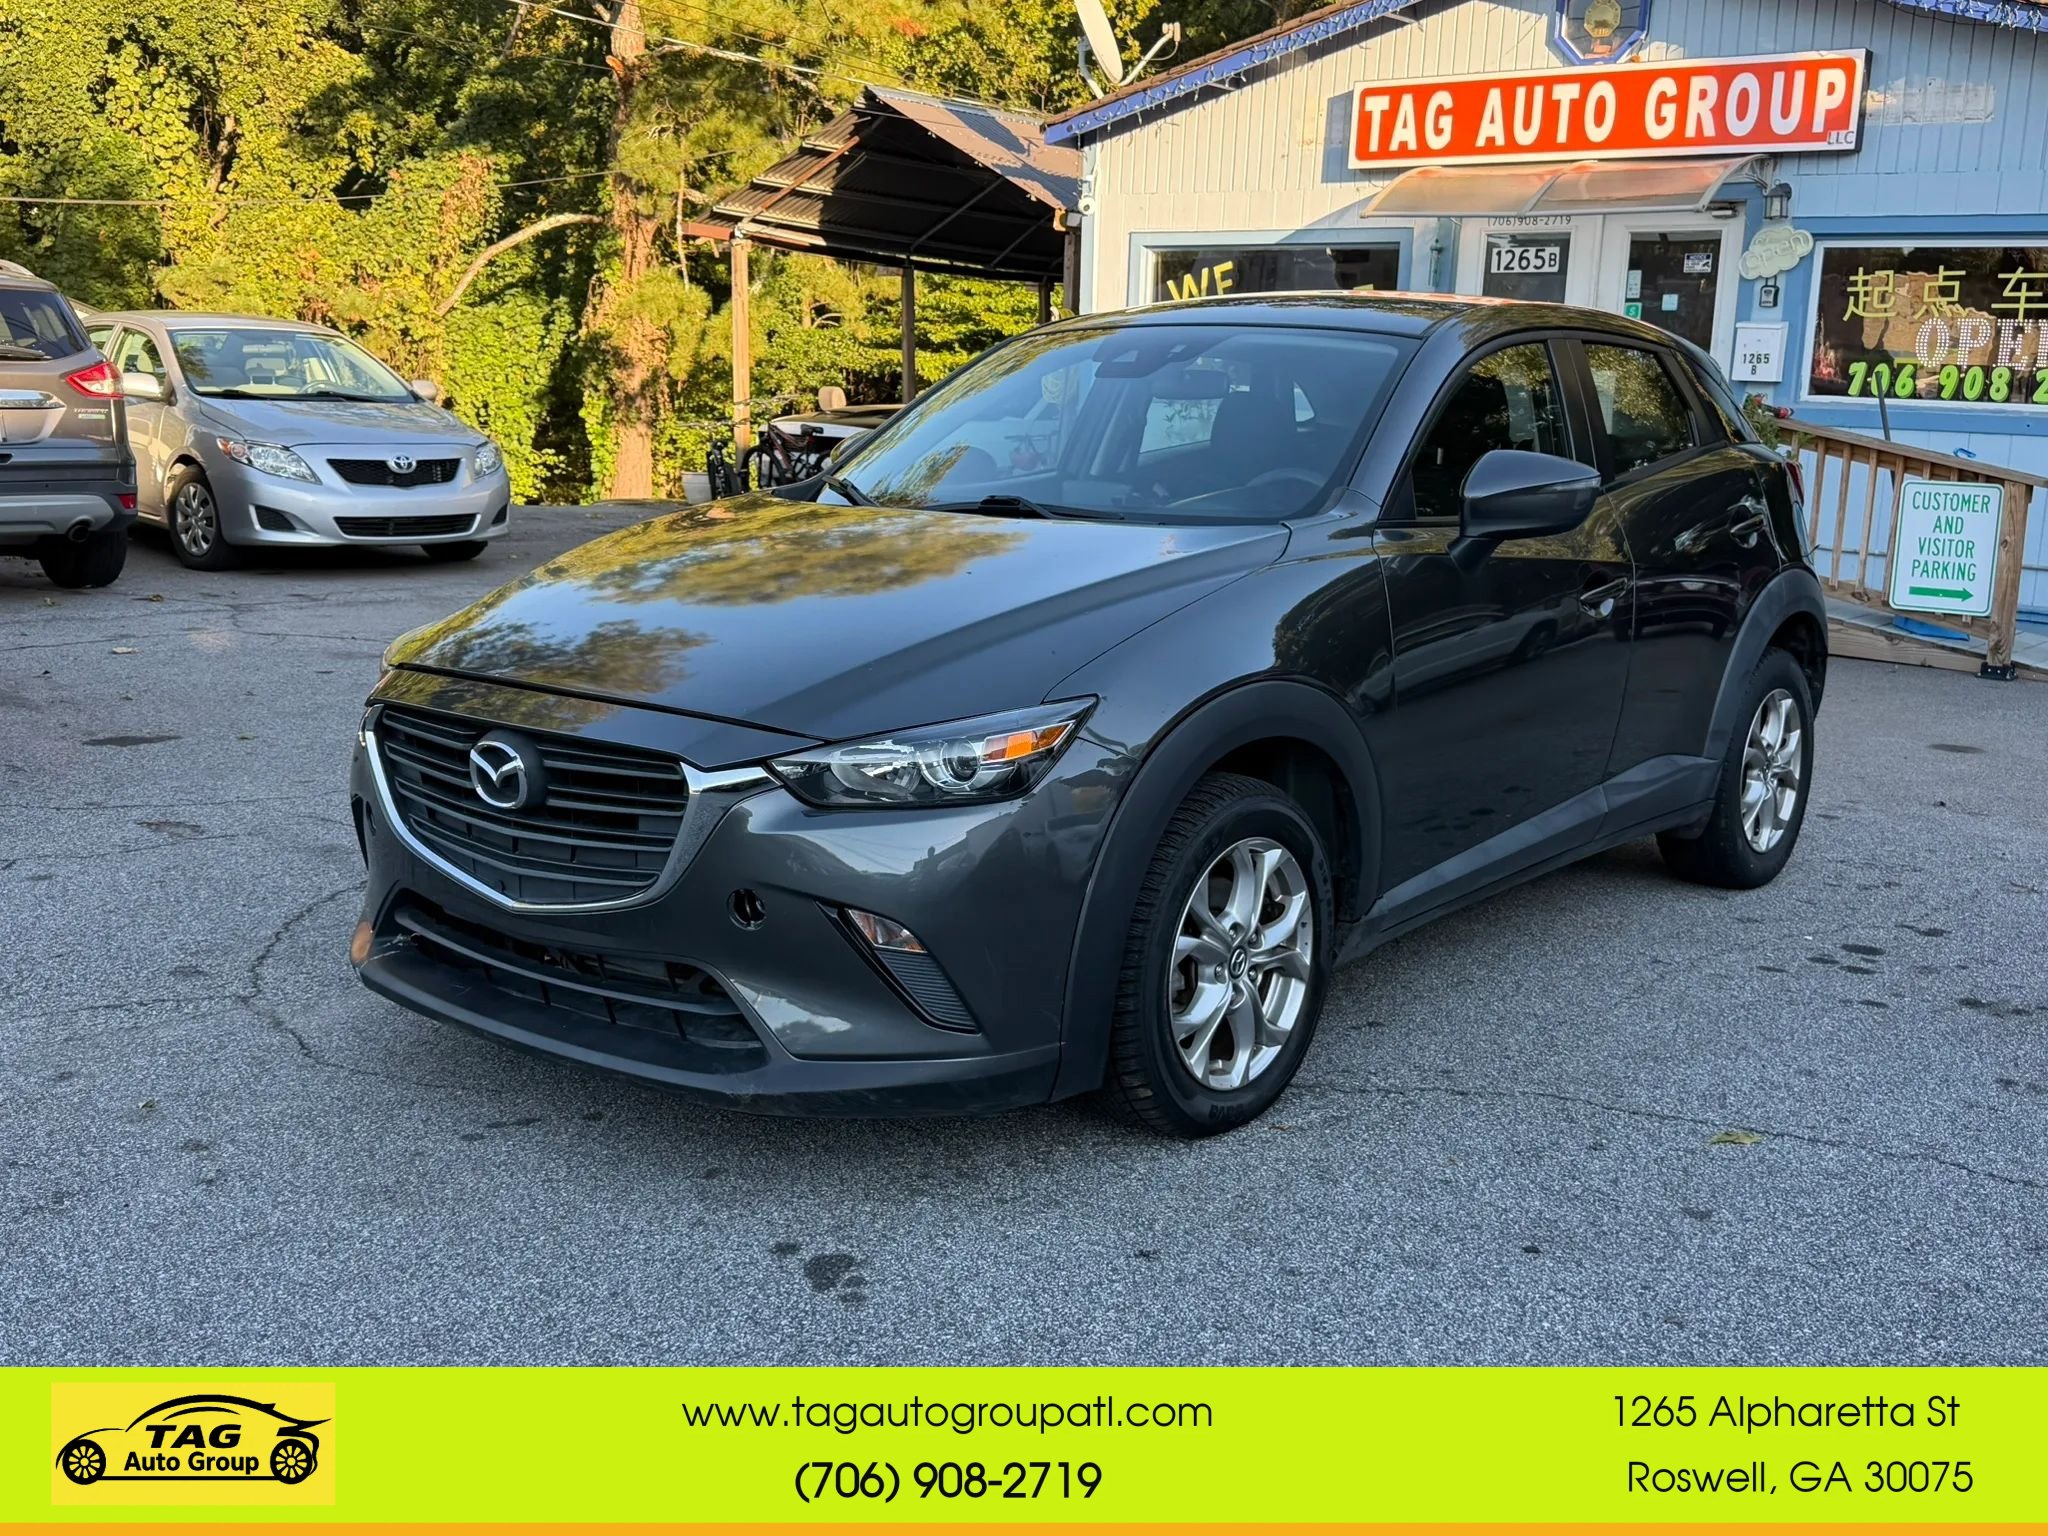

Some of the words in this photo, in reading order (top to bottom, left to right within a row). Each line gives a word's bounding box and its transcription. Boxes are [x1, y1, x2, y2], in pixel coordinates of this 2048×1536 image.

[1364, 90, 1454, 153] TAG
[1474, 79, 1617, 148] AUTO
[1644, 67, 1847, 141] GROUP
[1827, 130, 1855, 145] LLC
[1842, 264, 2048, 322] 起点车
[1743, 353, 1770, 364] 1265
[1750, 364, 1757, 375] B
[1847, 361, 1916, 399] 706
[1939, 365, 2012, 402] 908
[1912, 490, 1991, 513] CUSTOMER
[1932, 515, 1964, 535] AND
[1918, 537, 1975, 559] VISITOR
[1911, 559, 1977, 582] PARKING
